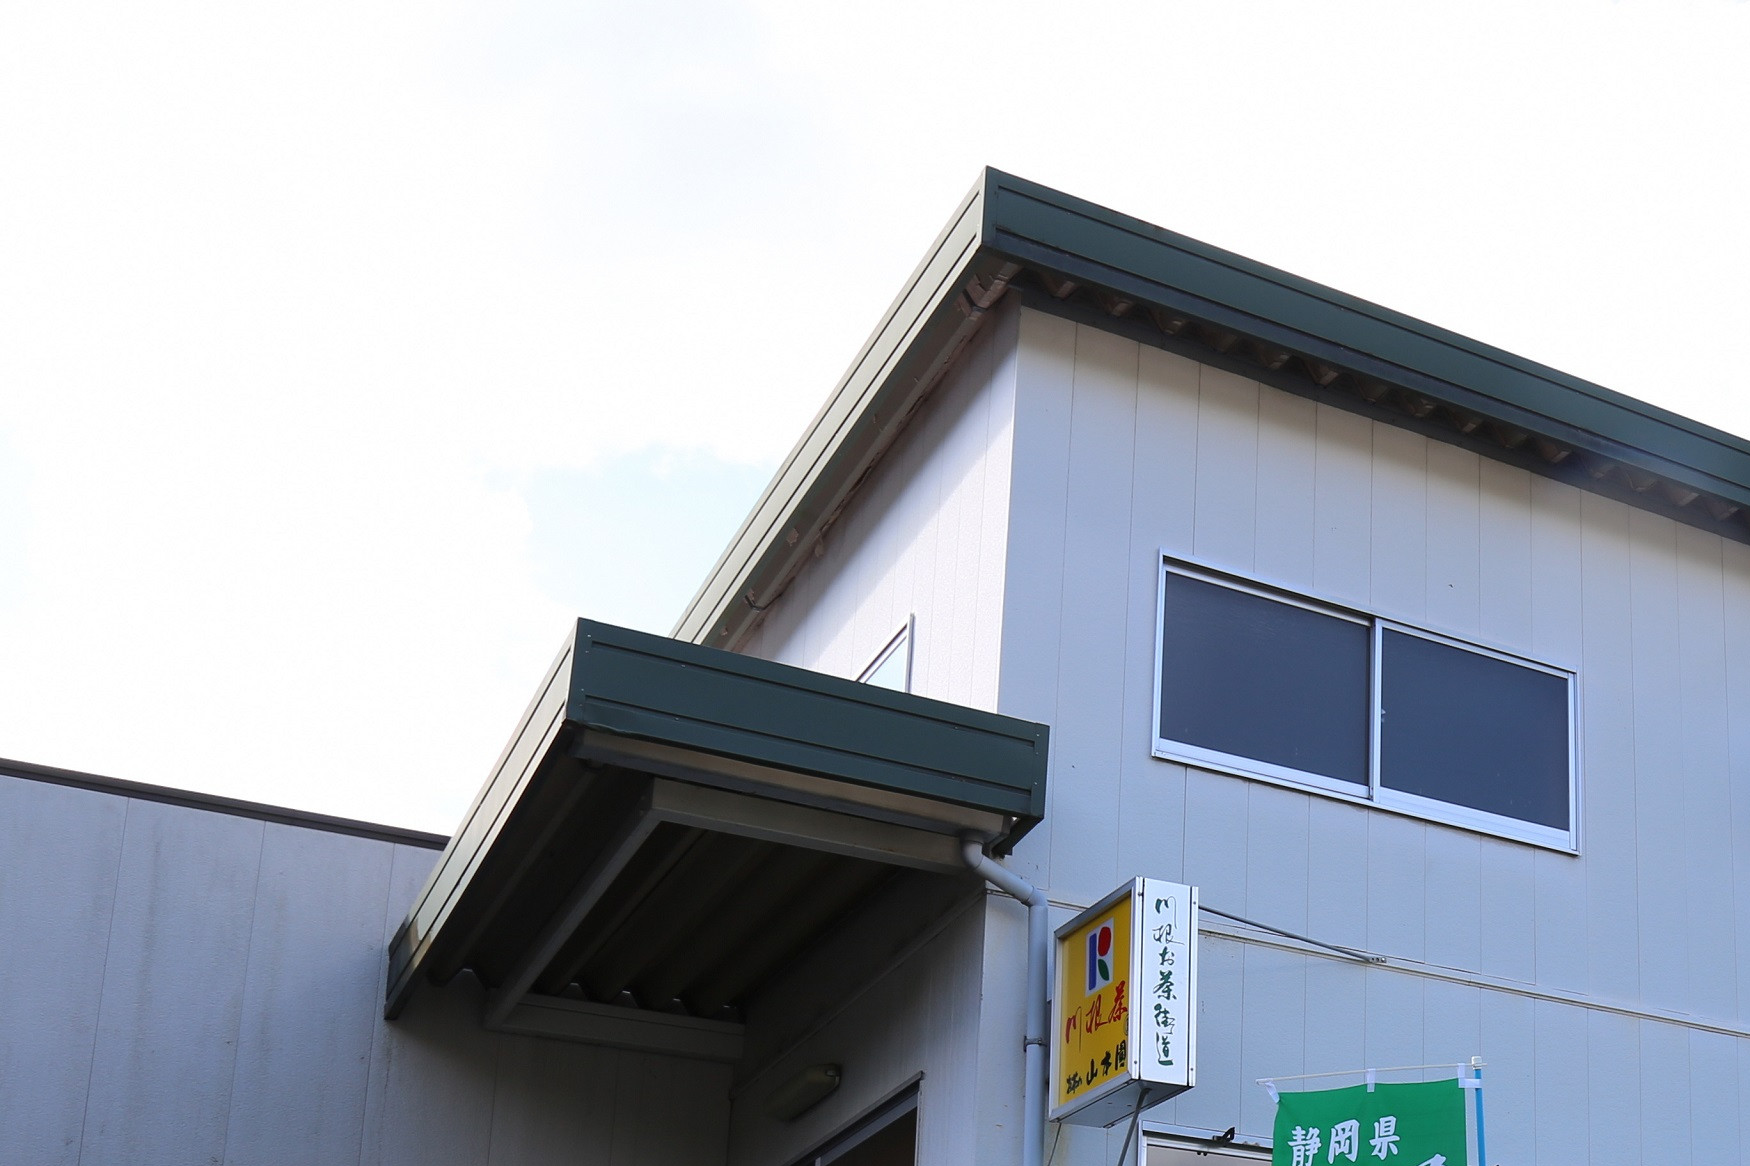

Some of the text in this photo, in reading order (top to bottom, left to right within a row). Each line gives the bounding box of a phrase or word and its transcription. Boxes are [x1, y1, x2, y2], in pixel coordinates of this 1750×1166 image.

[1065, 980, 1128, 1054] 川根茶
[1153, 896, 1184, 1066] 川根お茶街道
